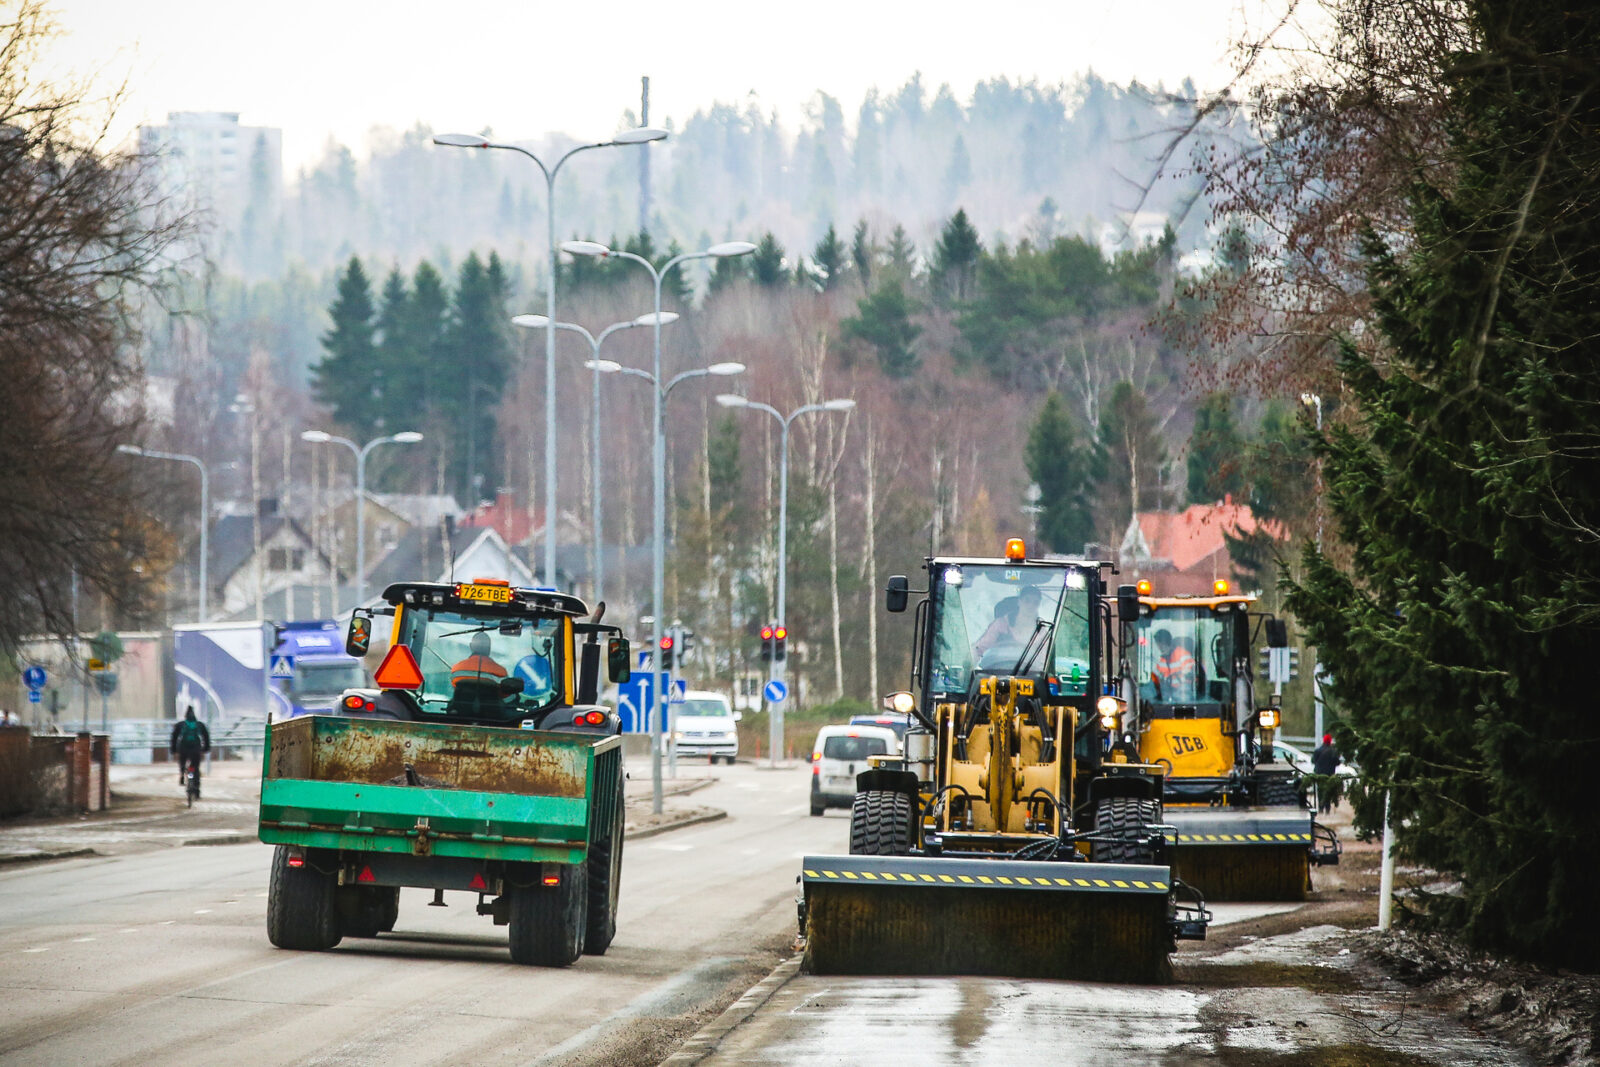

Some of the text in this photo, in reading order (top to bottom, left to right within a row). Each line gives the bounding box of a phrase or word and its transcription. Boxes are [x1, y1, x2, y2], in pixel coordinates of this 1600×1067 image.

[1005, 569, 1021, 580] CAT
[464, 587, 507, 601] 726-TBE
[1172, 735, 1204, 755] JCB
